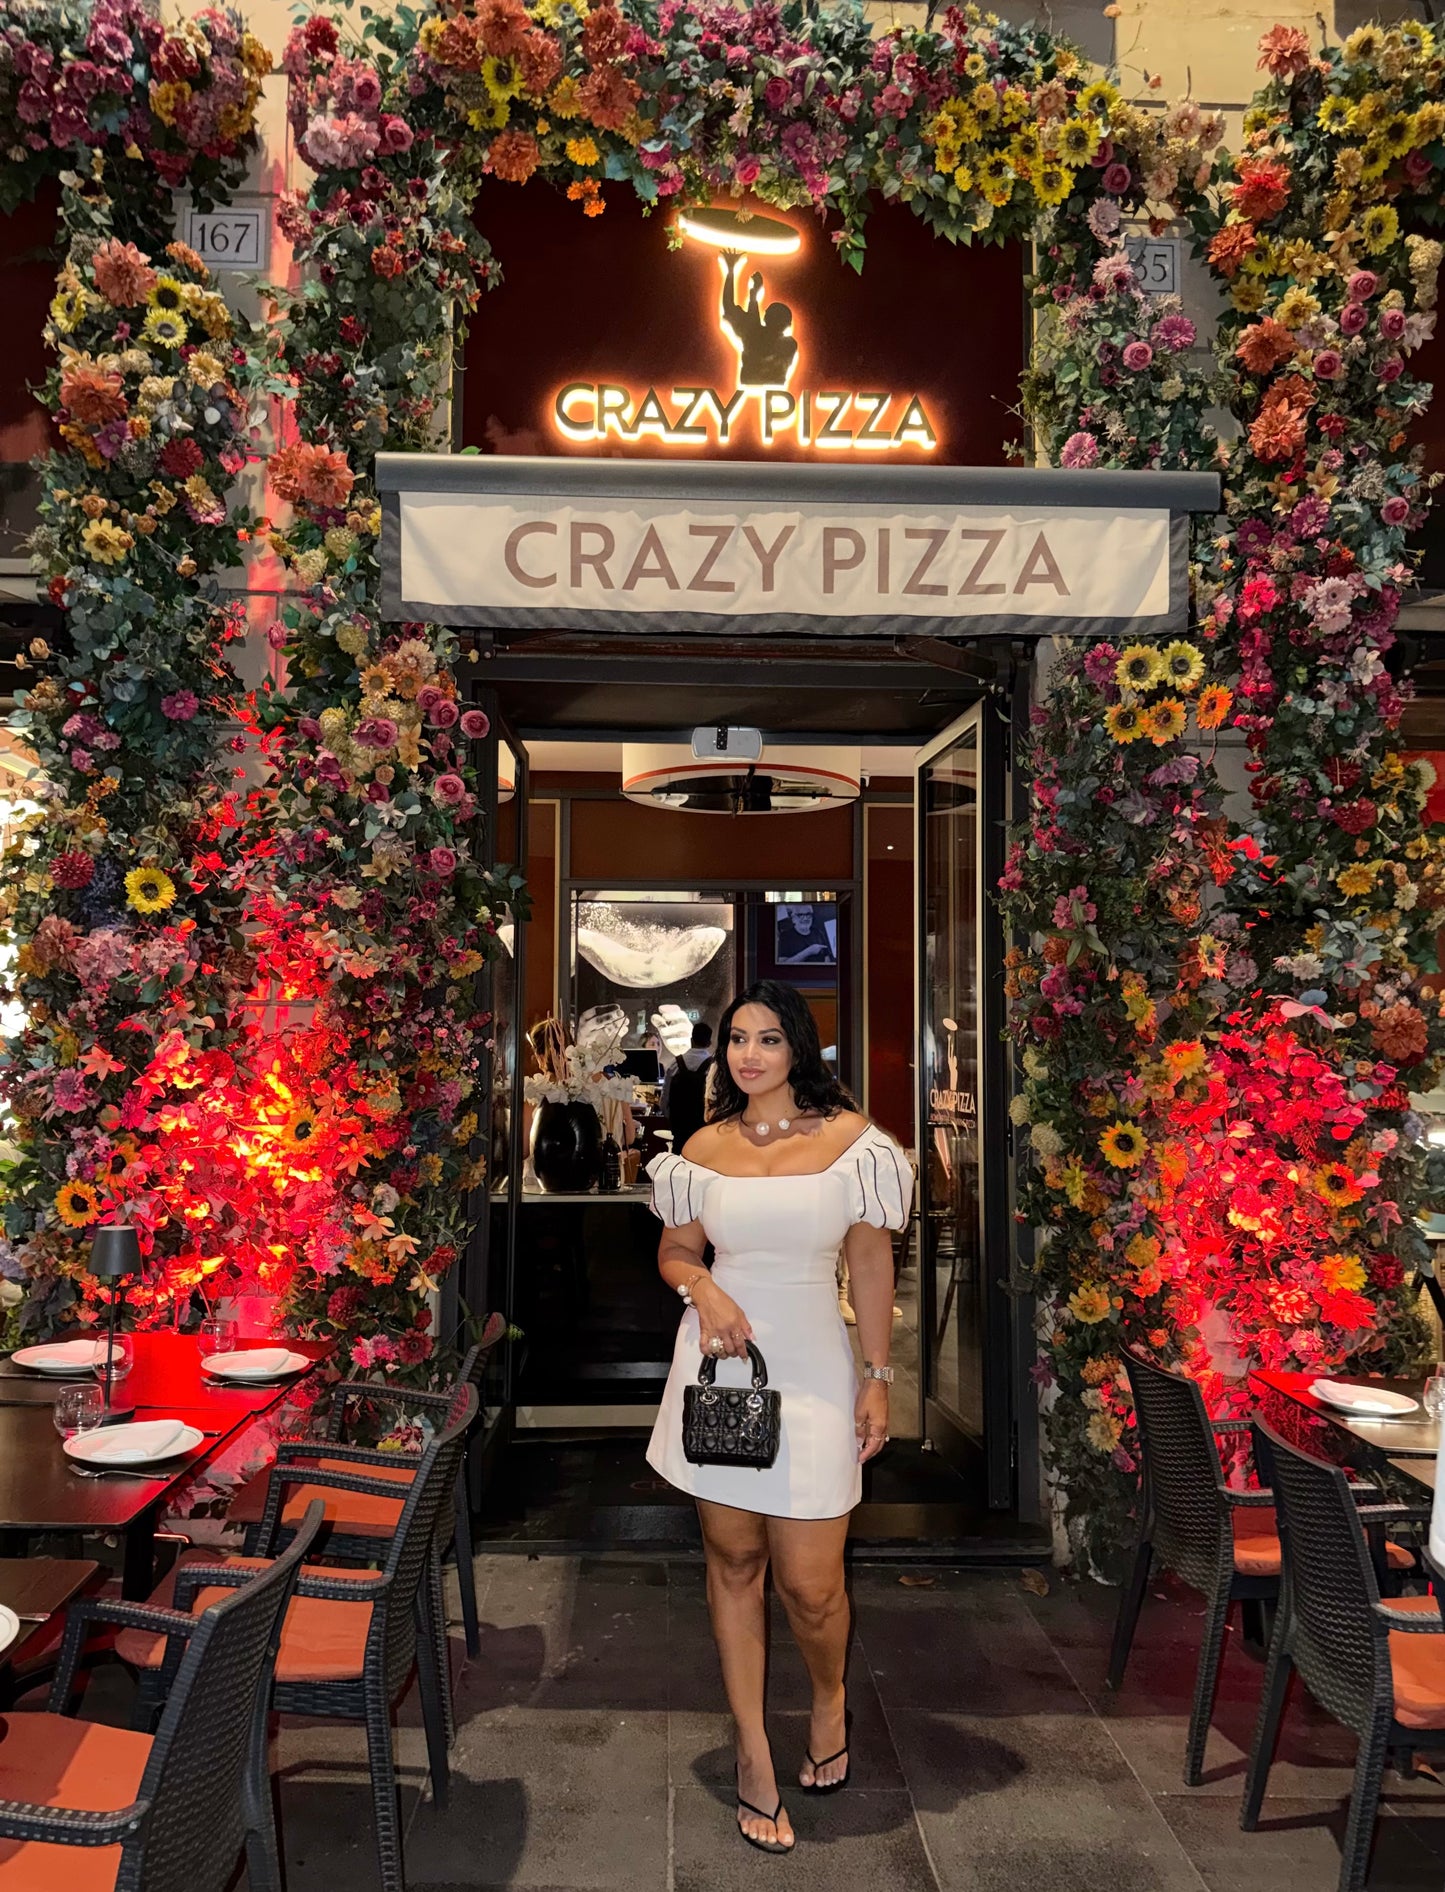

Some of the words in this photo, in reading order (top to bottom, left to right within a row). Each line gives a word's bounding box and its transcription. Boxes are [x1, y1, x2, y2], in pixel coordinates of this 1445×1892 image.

[198, 222, 251, 253] 167
[555, 382, 745, 438] CRAZY
[764, 389, 937, 443] PIZZA
[504, 520, 797, 593] CRAZY
[822, 526, 1072, 596] PIZZA
[930, 1088, 953, 1111] CRAZY
[952, 1091, 976, 1115] PIZZA
